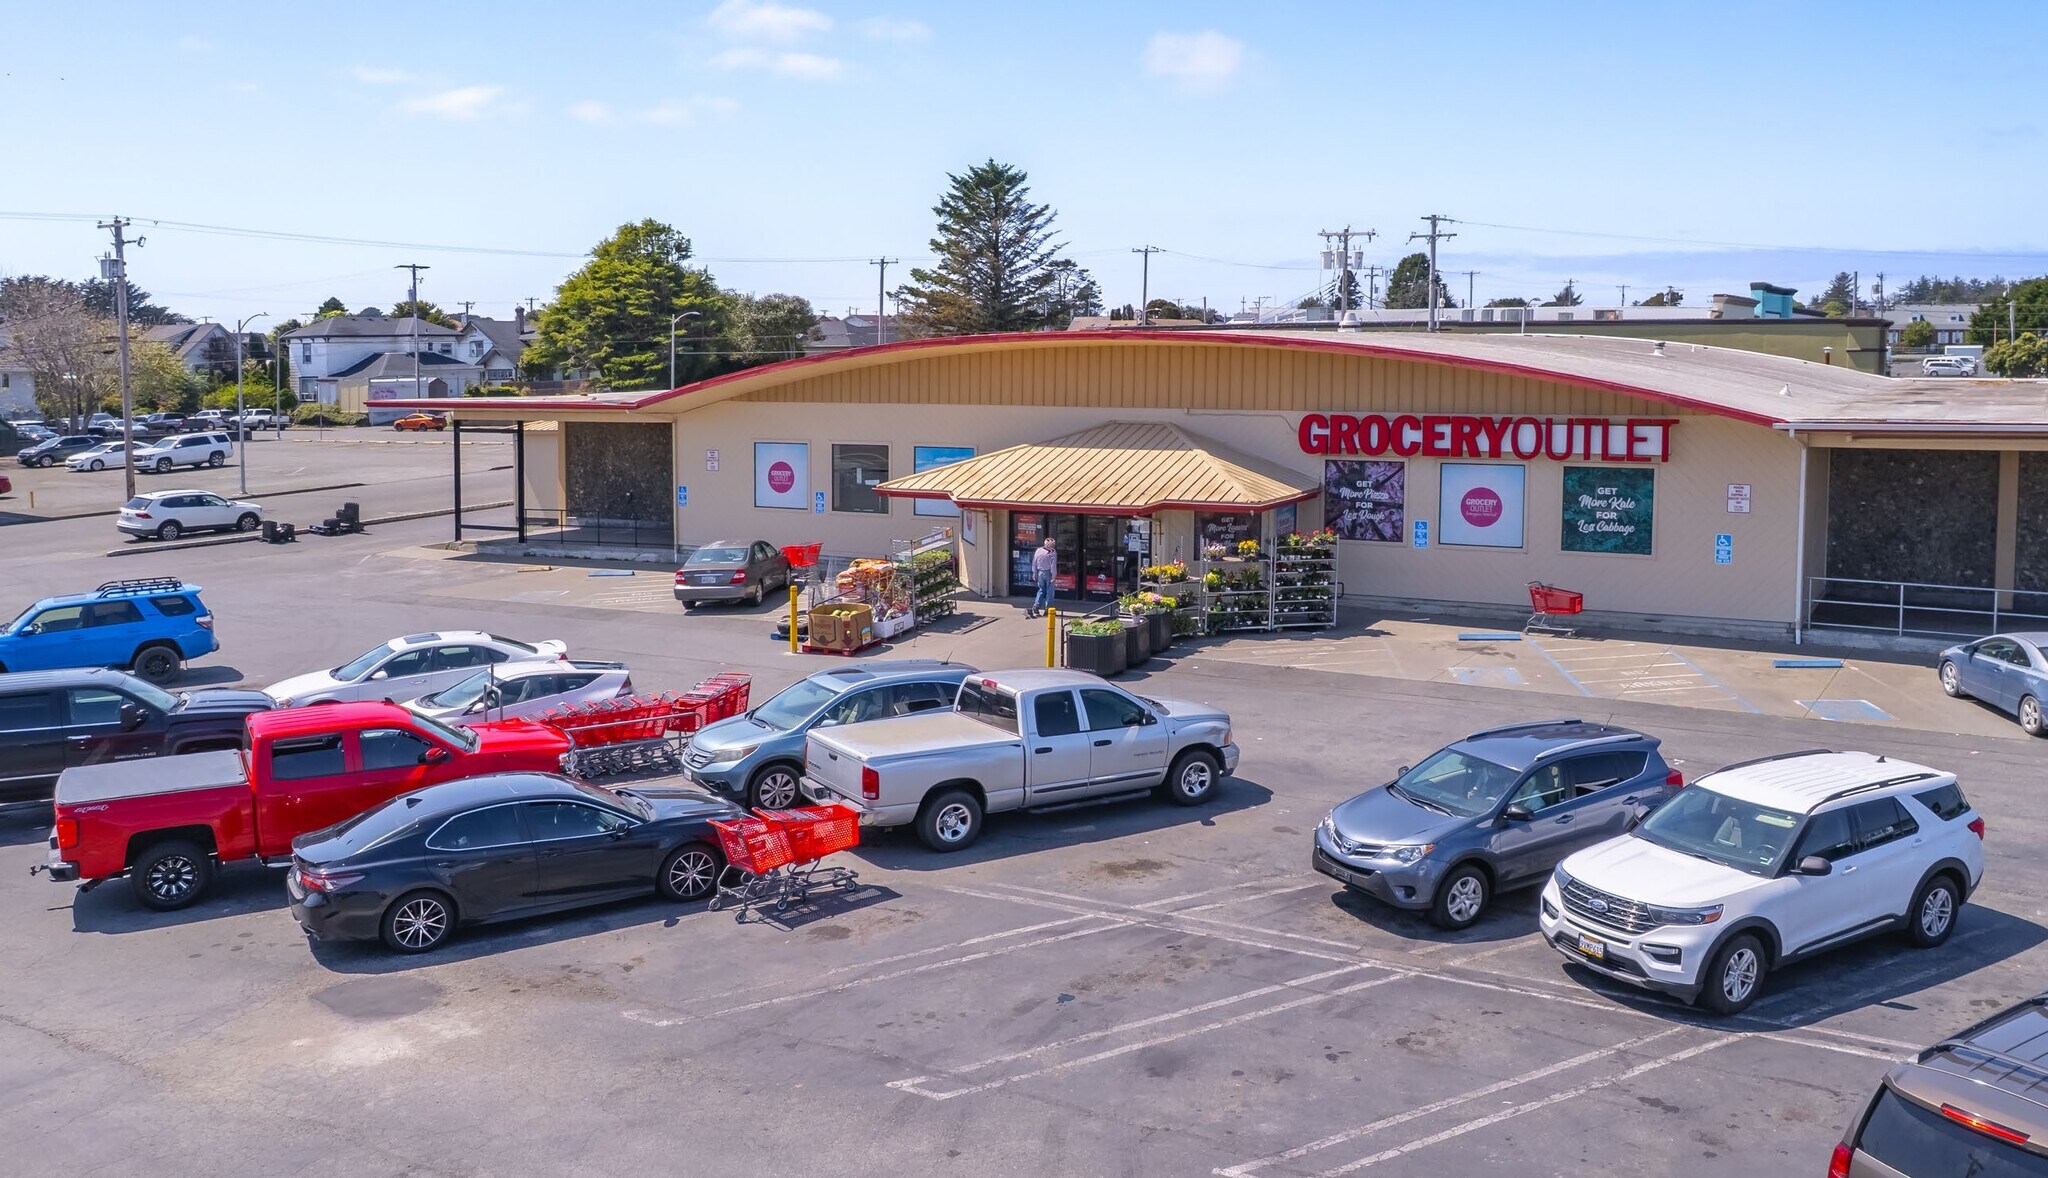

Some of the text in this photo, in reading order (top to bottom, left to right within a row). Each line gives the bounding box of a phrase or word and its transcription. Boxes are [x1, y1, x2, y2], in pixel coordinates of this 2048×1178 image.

[1356, 480, 1374, 488] GET
[1339, 487, 1363, 499] More
[1597, 487, 1618, 495] GET
[1355, 501, 1374, 509] FOR
[1466, 498, 1497, 506] GROCERY
[1579, 495, 1636, 510] More Kale
[1470, 505, 1493, 513] OUTLET
[1343, 509, 1386, 522] Less Dough
[1596, 511, 1617, 519] FOR
[1577, 520, 1636, 536] Less Cabbage
